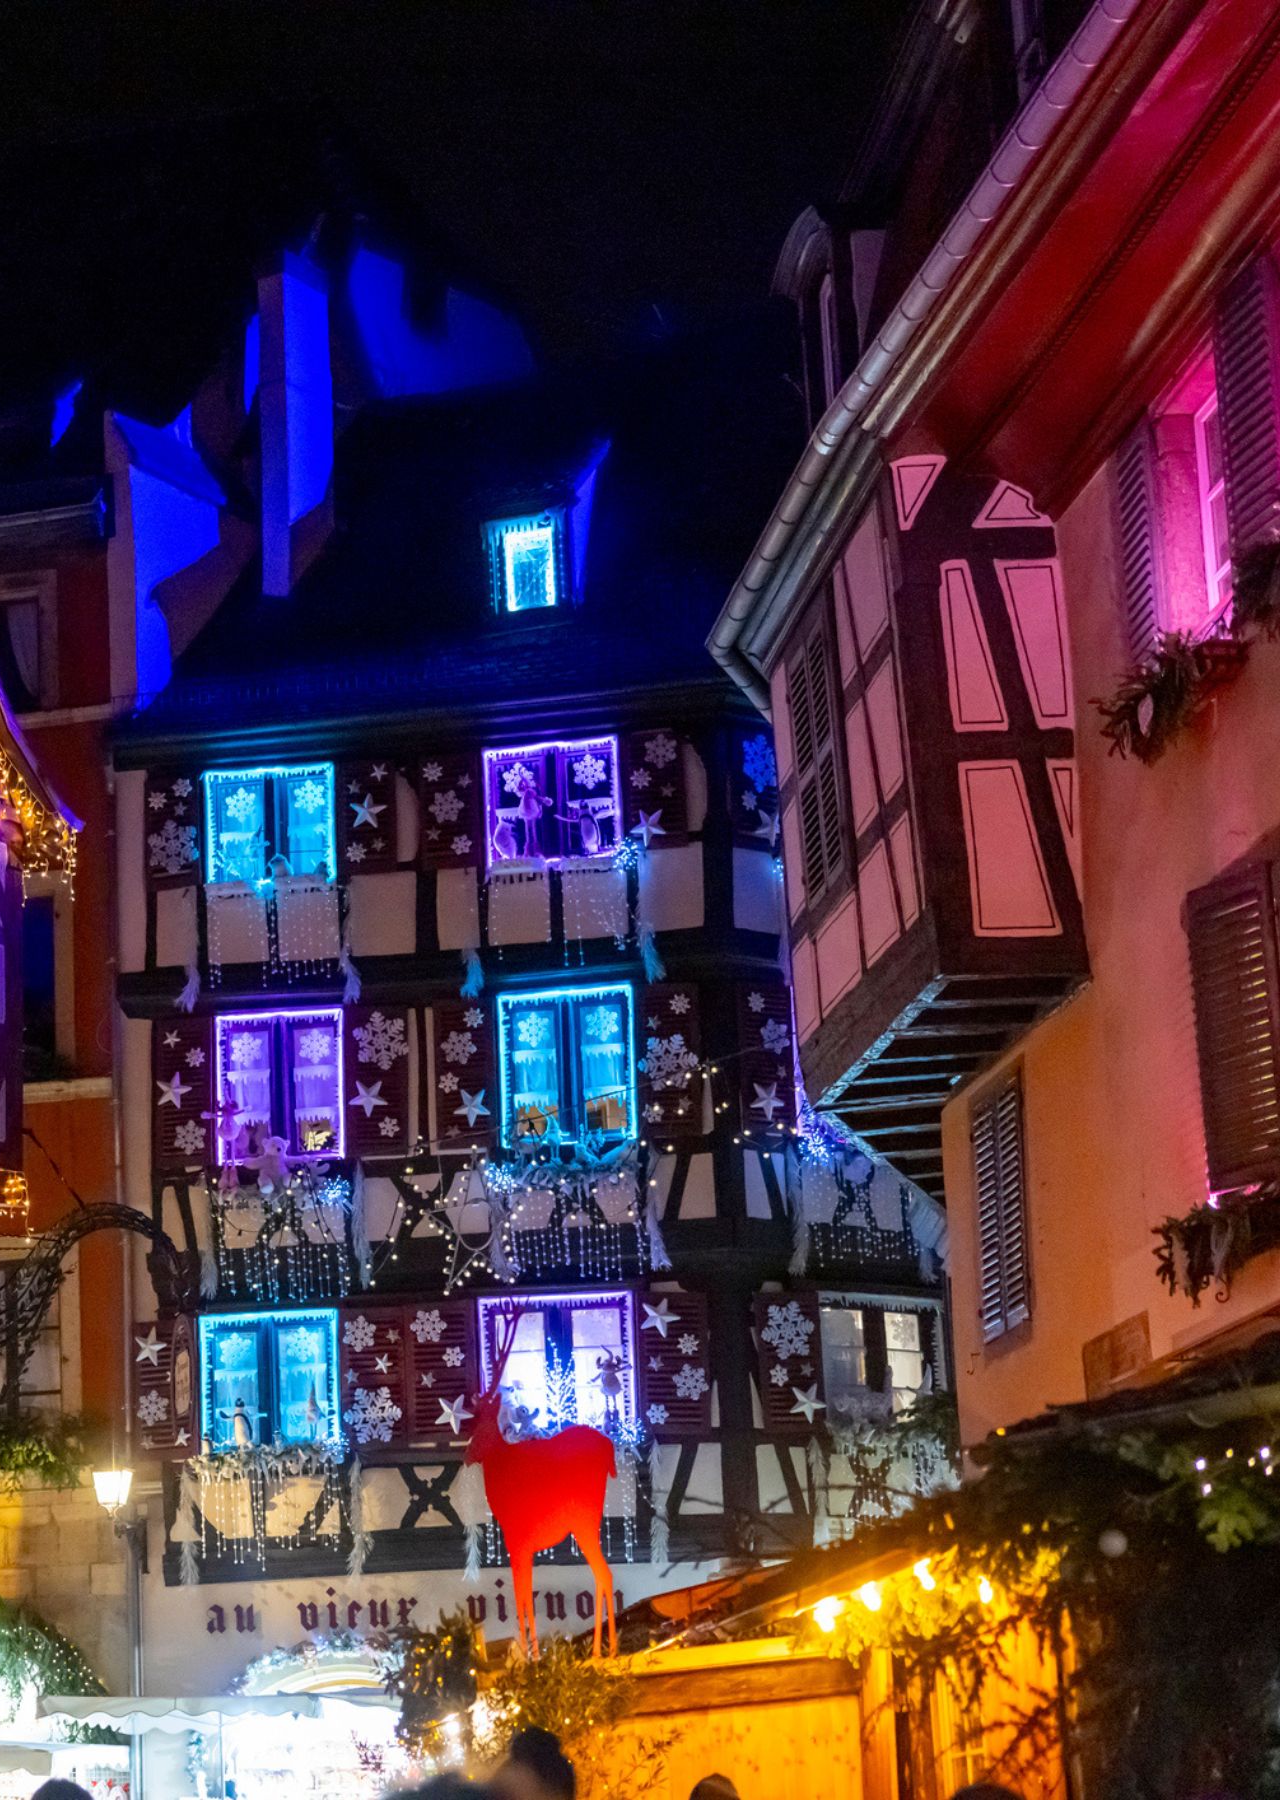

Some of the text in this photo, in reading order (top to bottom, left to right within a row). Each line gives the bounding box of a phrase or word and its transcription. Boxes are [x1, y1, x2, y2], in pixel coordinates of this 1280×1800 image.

[206, 1579, 624, 1634] au vieux vino
